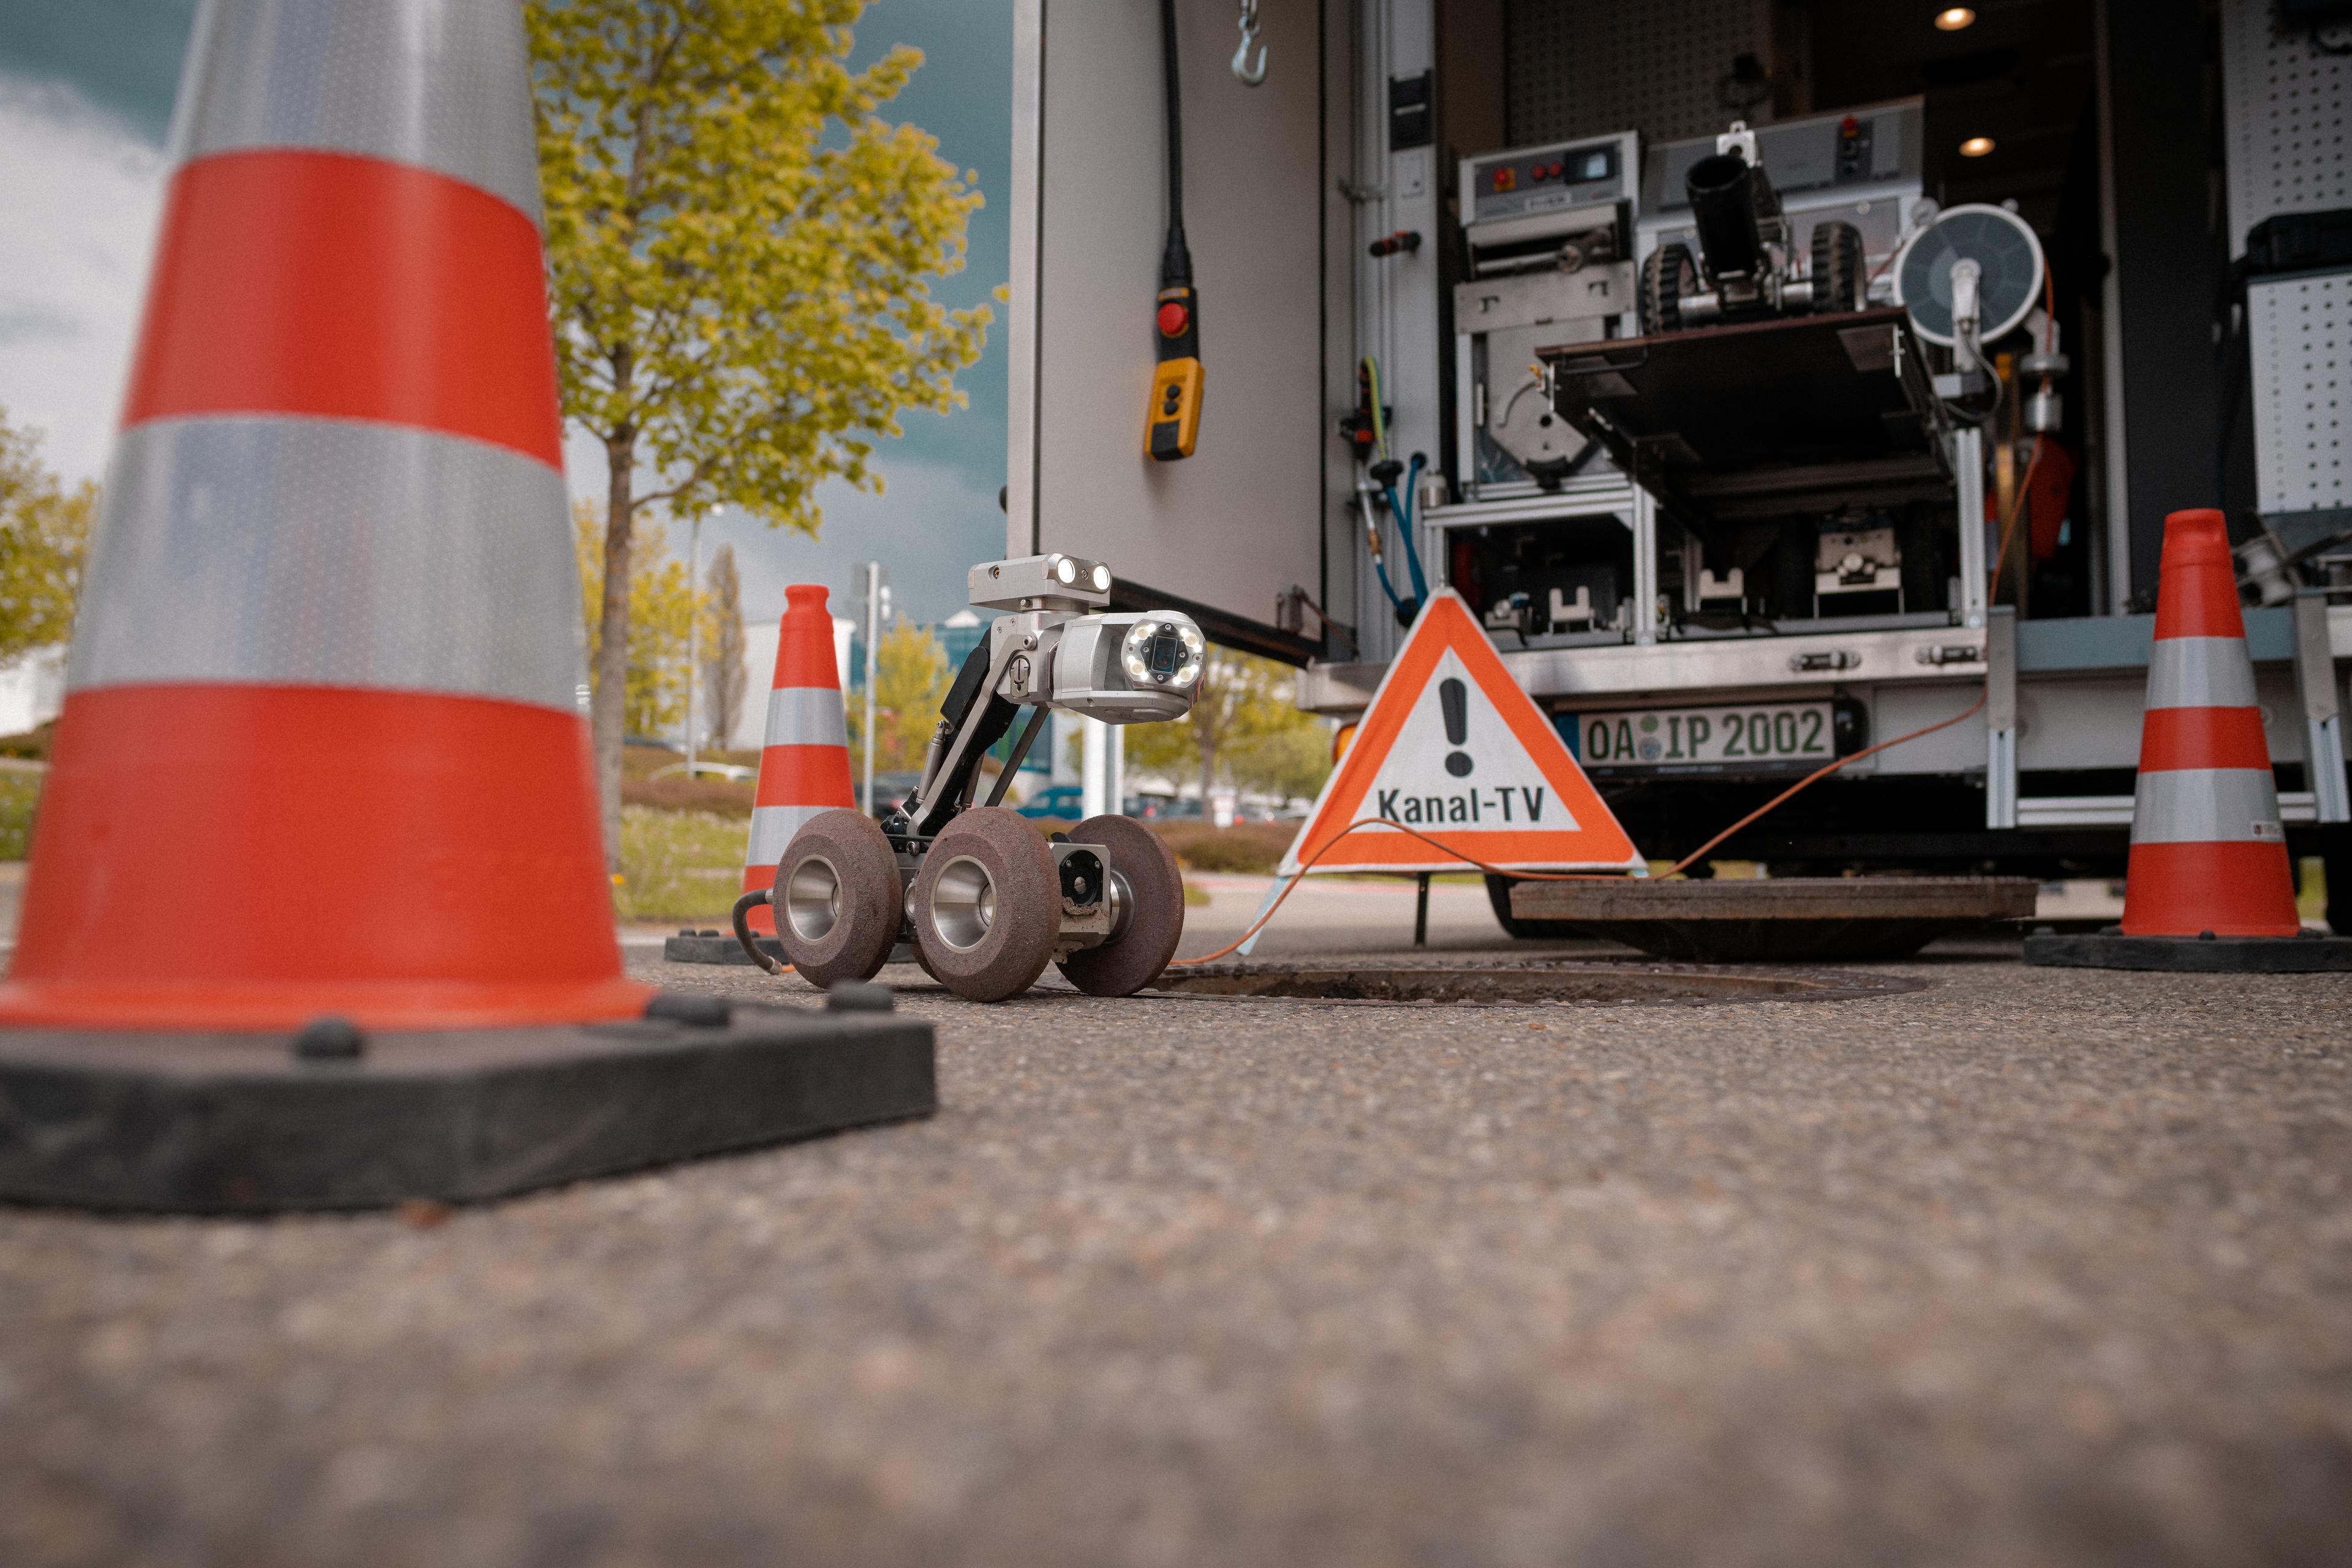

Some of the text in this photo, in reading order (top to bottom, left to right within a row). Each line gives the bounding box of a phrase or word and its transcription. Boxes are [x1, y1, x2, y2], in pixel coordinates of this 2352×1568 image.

[1588, 709, 1825, 761] OA IP 2002
[1379, 787, 1544, 823] Kanal-TV
